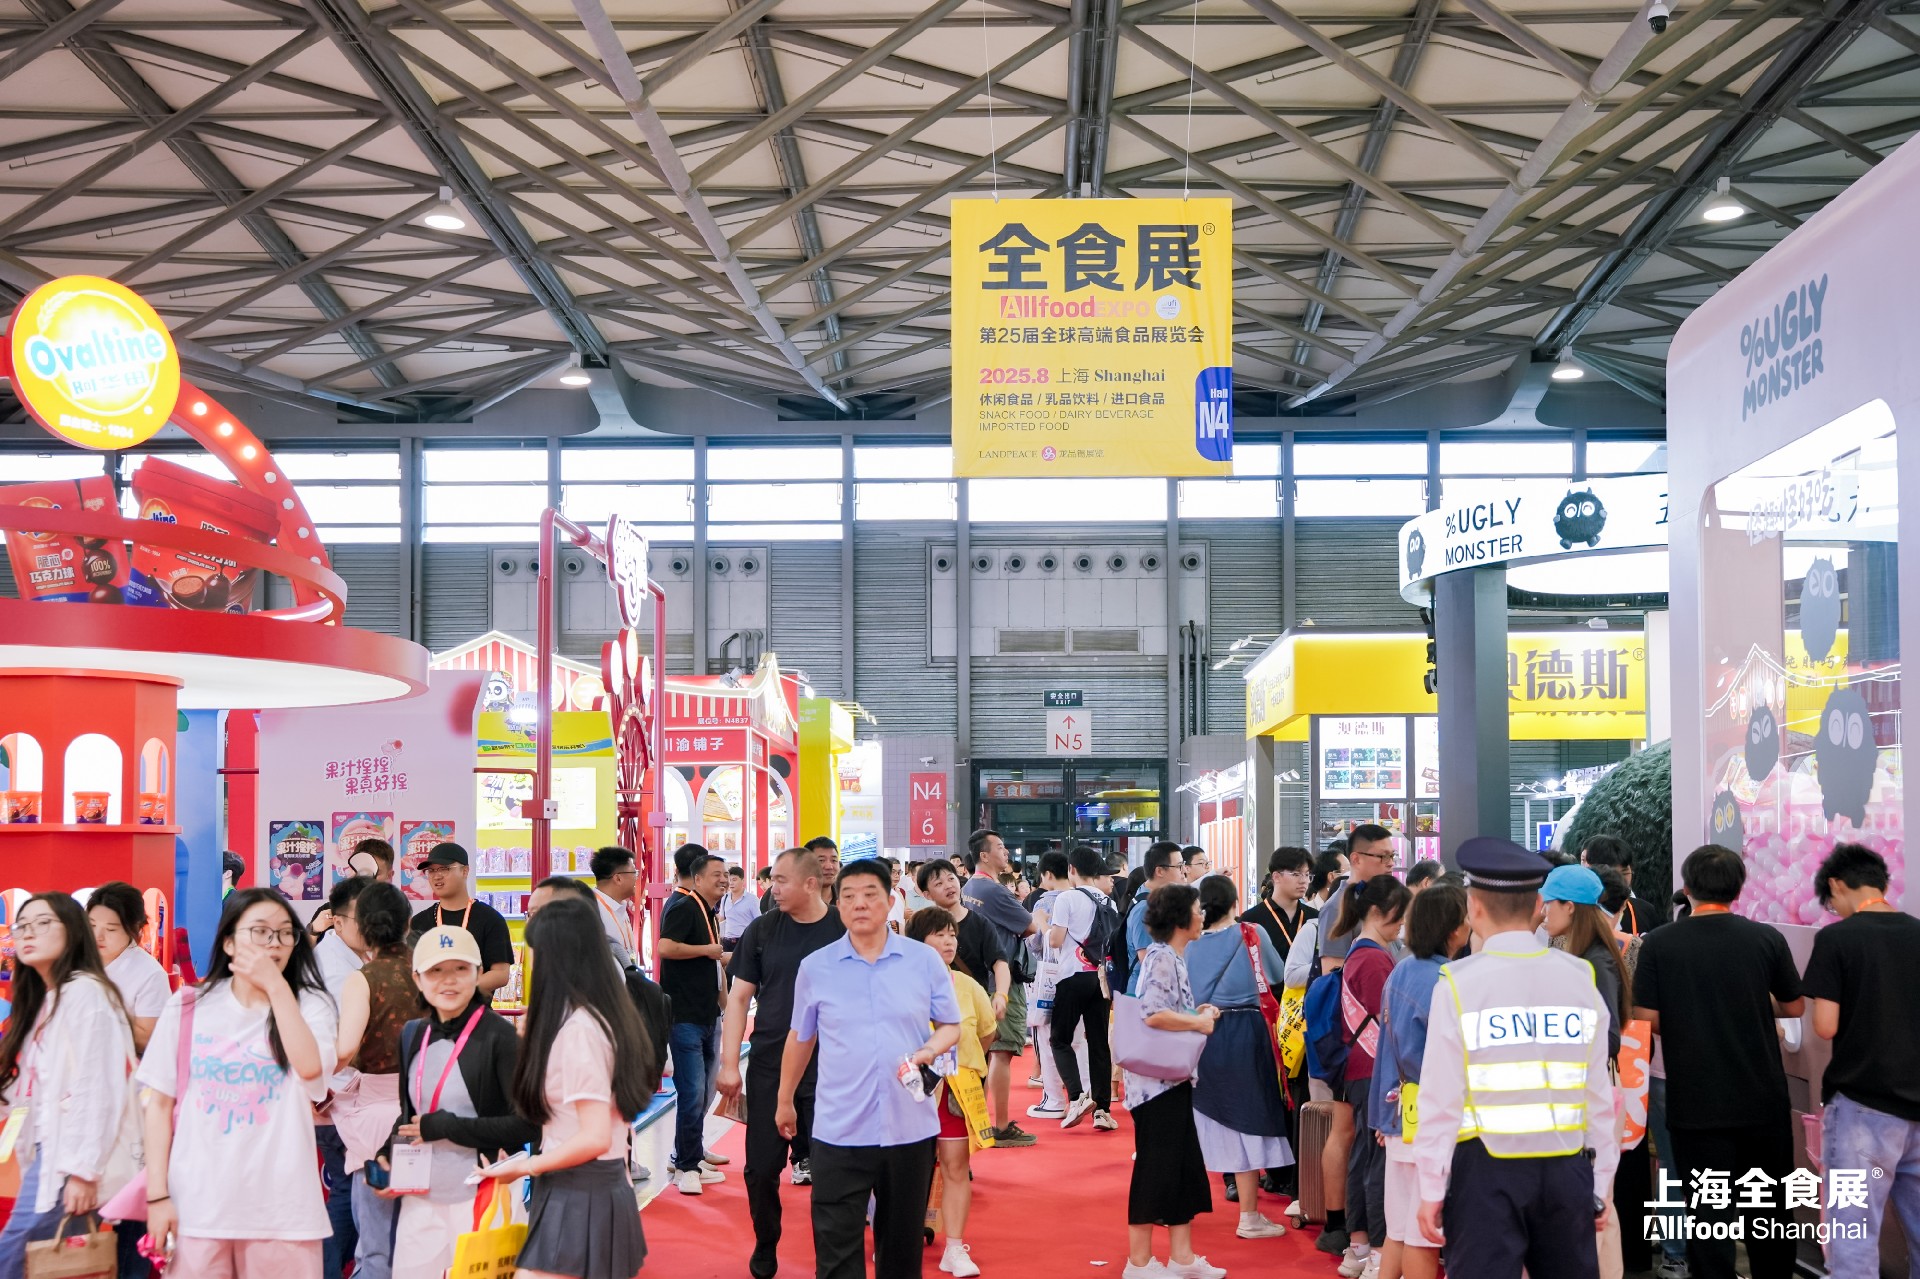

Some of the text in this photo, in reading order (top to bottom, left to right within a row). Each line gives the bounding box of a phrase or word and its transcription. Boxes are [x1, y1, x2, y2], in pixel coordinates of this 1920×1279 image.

[979, 326, 1205, 344] 第25届全球高端食品展览会
[30, 326, 163, 376] Ovaltine
[979, 367, 1166, 384] 2025.8 上海 Shanghai
[1742, 338, 1824, 422] MONSTER
[1210, 388, 1229, 399] Hall
[979, 410, 1016, 419] SNACK
[1019, 410, 1050, 419] FOOD
[1059, 410, 1092, 419] DAIRY
[1095, 410, 1154, 419] BEVERAGE
[1199, 401, 1230, 439] N4
[979, 422, 1070, 431] IMPORTED FOOD
[979, 450, 1037, 459] LANDPEACE
[1445, 534, 1523, 567] MONSTER
[91, 559, 111, 573] 100%
[29, 566, 75, 584] 巧克力球
[1055, 733, 1082, 750] N5
[325, 756, 390, 780] 果汁捏捏
[345, 772, 408, 796] 果真好捏
[913, 782, 942, 801] N4
[993, 784, 1032, 797] 全食展
[922, 818, 934, 835] 6
